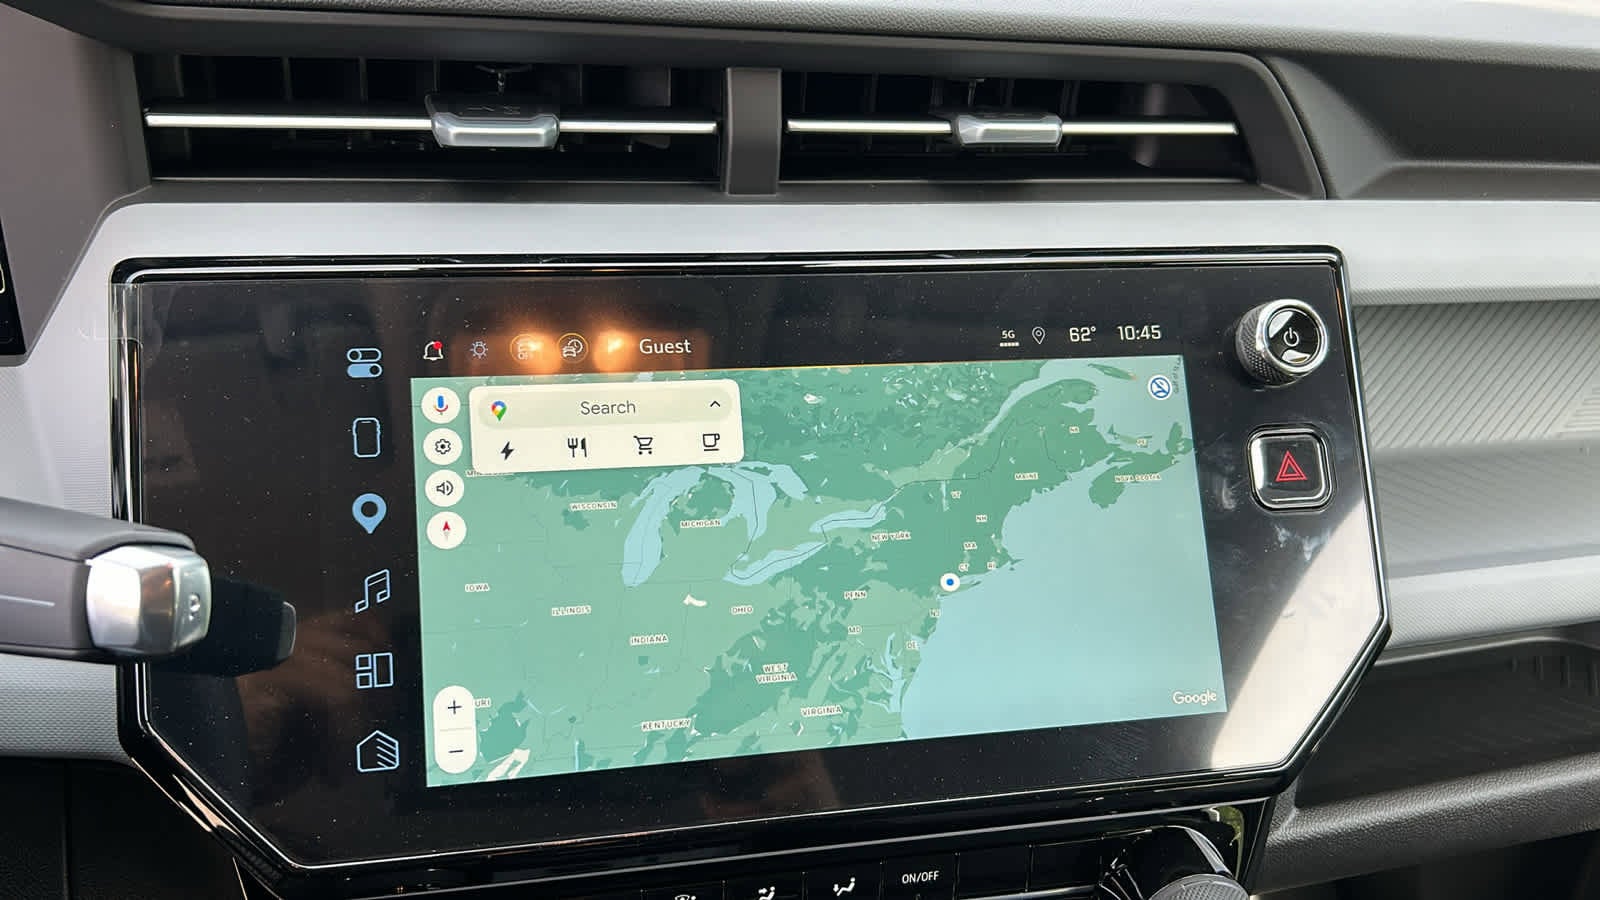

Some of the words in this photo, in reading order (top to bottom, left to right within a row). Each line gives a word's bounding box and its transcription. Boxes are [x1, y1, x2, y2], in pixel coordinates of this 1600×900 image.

[1001, 329, 1016, 340] 5G
[1069, 325, 1097, 342] 62°
[1117, 324, 1162, 341] 10:45
[639, 338, 691, 355] Guest
[579, 399, 636, 416] Search
[1015, 472, 1038, 480] MAINE
[1115, 475, 1134, 483] NOVA
[1135, 473, 1161, 482] SCOTIA
[571, 501, 617, 510] WISCONSIN
[681, 518, 721, 528] MICHIGAN
[871, 534, 888, 542] NEW
[889, 531, 910, 540] YORK
[465, 583, 490, 592] IOWA
[844, 591, 866, 599] PENN
[552, 605, 591, 615] ILLINOIS
[731, 606, 754, 614] OHIO
[931, 609, 940, 617] NJ
[630, 634, 668, 644] INDIANA
[907, 641, 917, 649] DE
[763, 663, 788, 673] WEST
[757, 673, 797, 683] VIRGINIA
[1172, 688, 1217, 706] Google
[801, 705, 842, 716] VIRGINIA
[642, 718, 691, 731] KENTUCKY
[901, 870, 940, 884] ON/OFF
